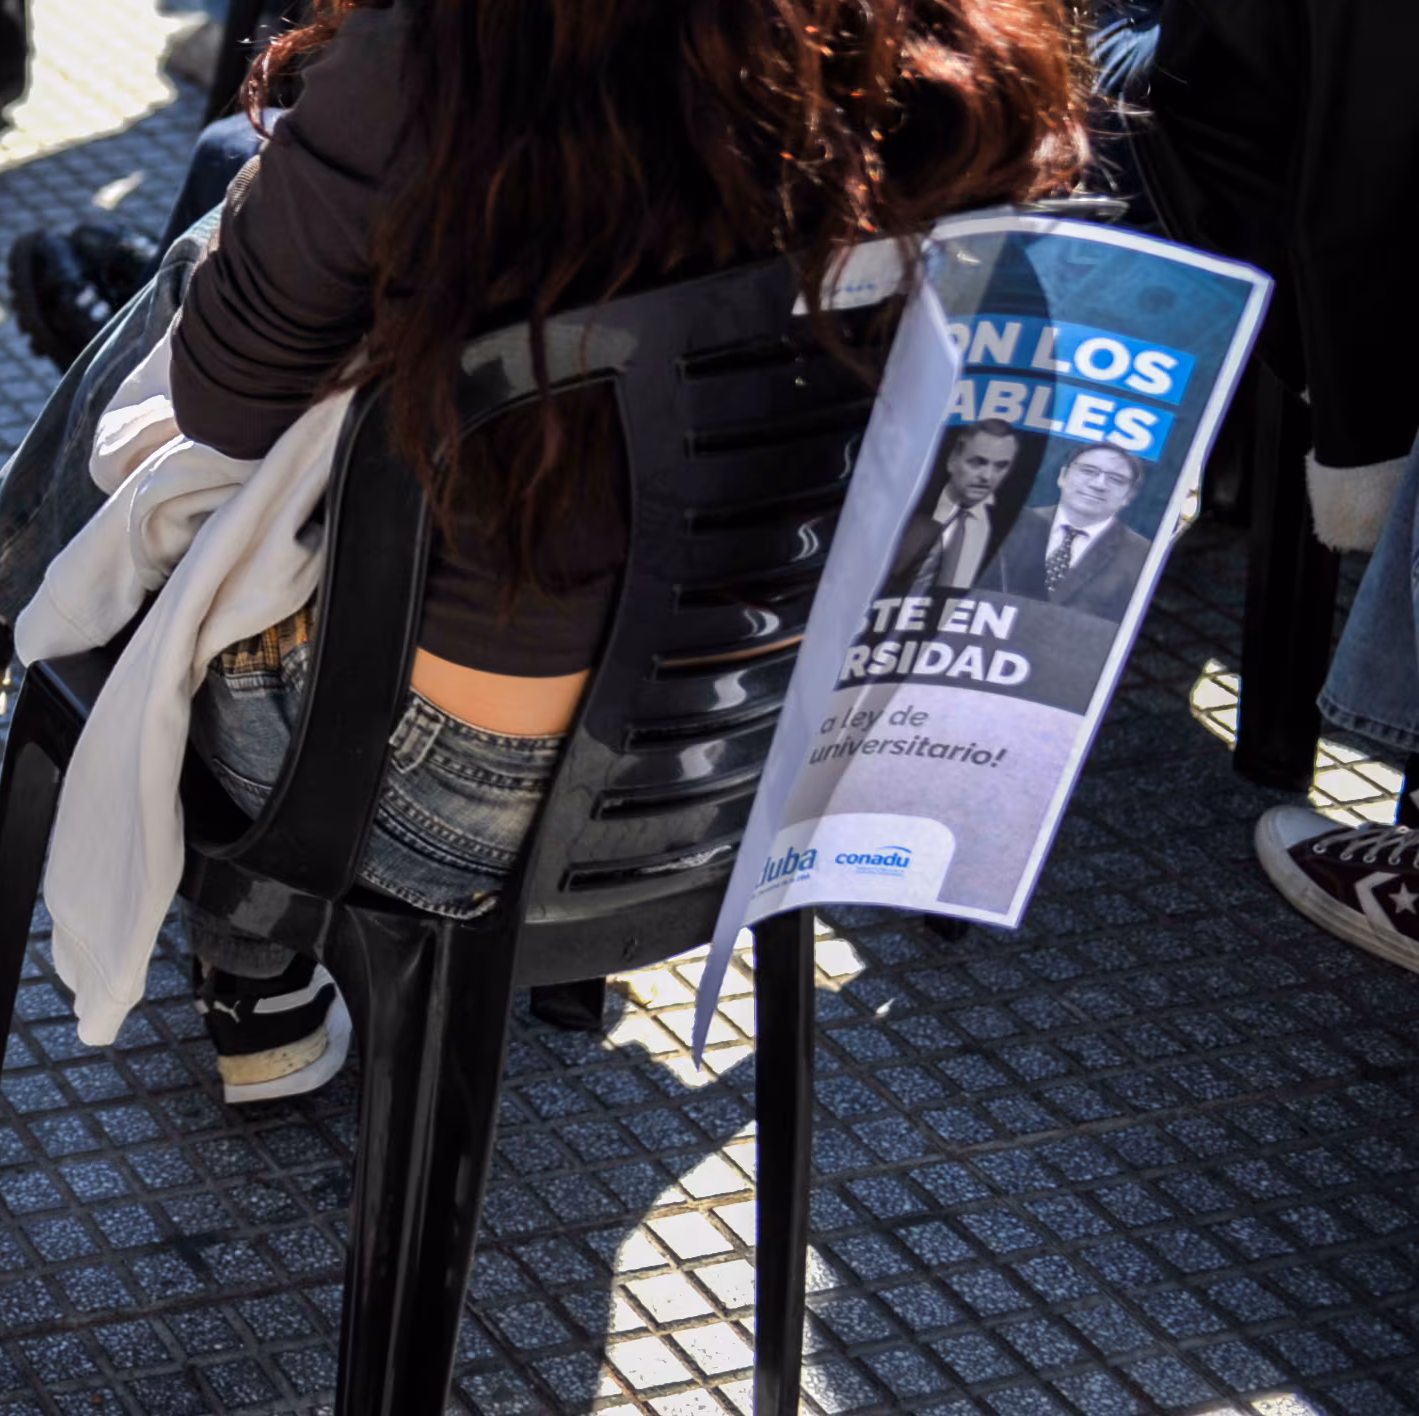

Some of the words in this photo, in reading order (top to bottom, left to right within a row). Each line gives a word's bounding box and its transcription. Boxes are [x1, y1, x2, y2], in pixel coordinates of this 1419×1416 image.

[1031, 326, 1180, 395] LOS
[937, 597, 1019, 640] EN
[841, 705, 884, 729] ley
[889, 705, 929, 727] de
[809, 734, 1008, 769] universitario!
[834, 852, 911, 869] conadu
